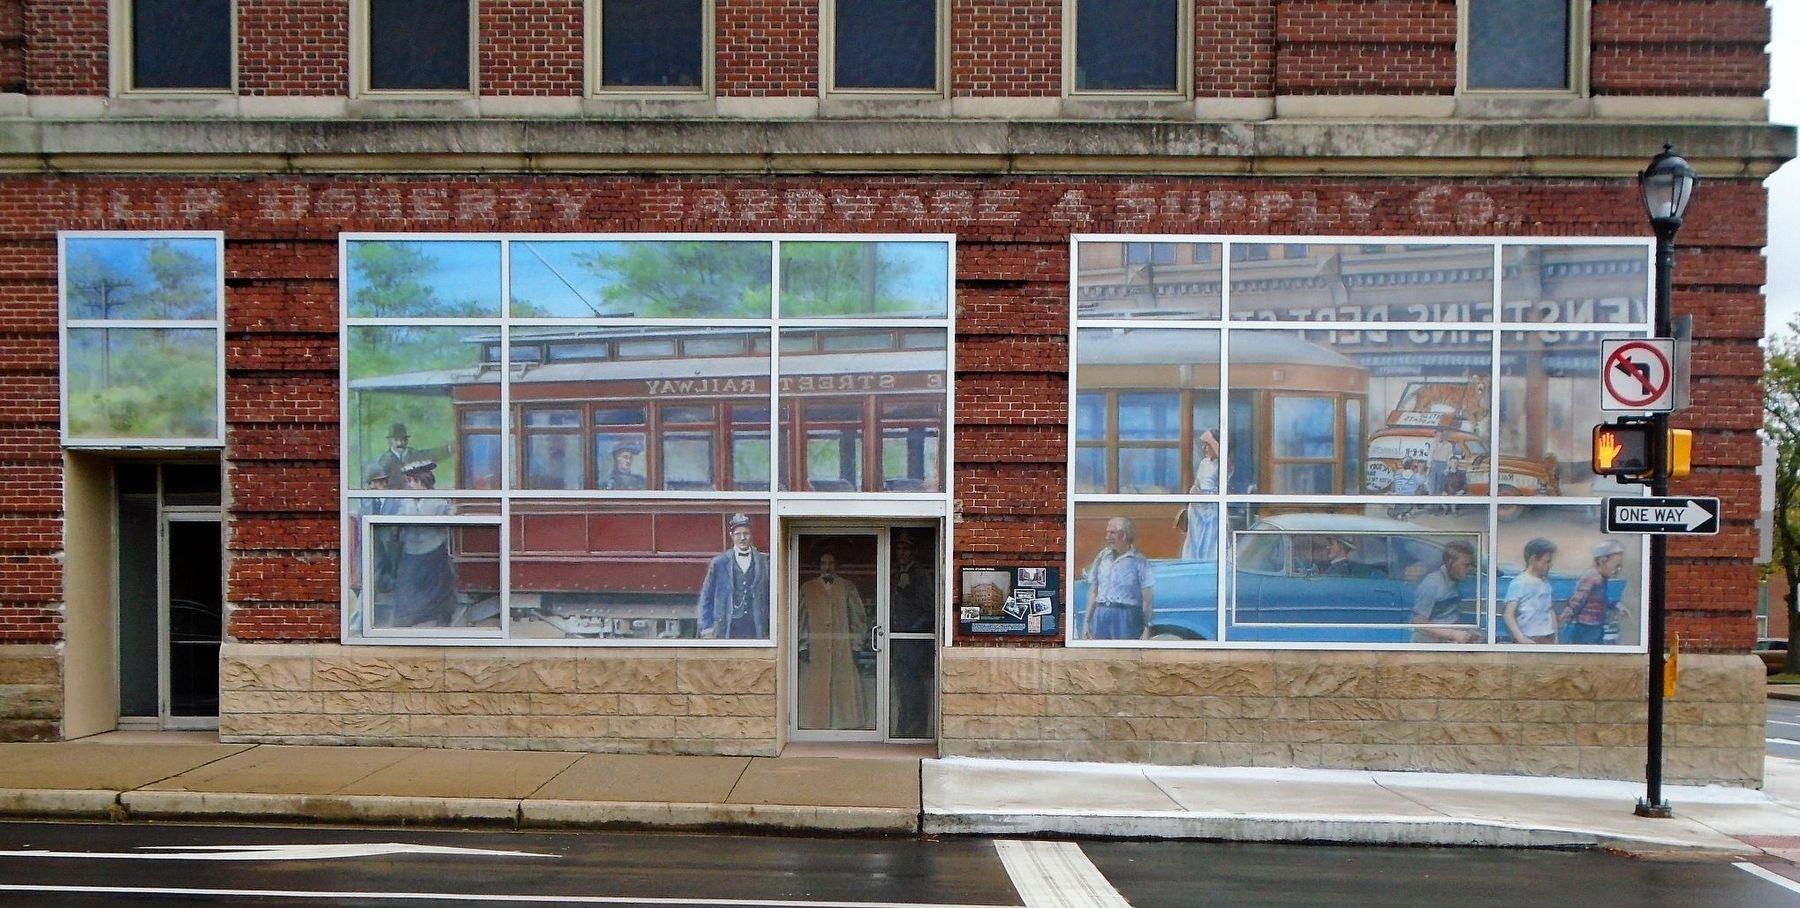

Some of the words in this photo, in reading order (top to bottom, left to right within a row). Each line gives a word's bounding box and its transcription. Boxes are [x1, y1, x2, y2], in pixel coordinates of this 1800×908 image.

[1115, 183, 1387, 222] SUPPLY
[1619, 508, 1649, 522] ONE
[1655, 508, 1685, 522] WAY
